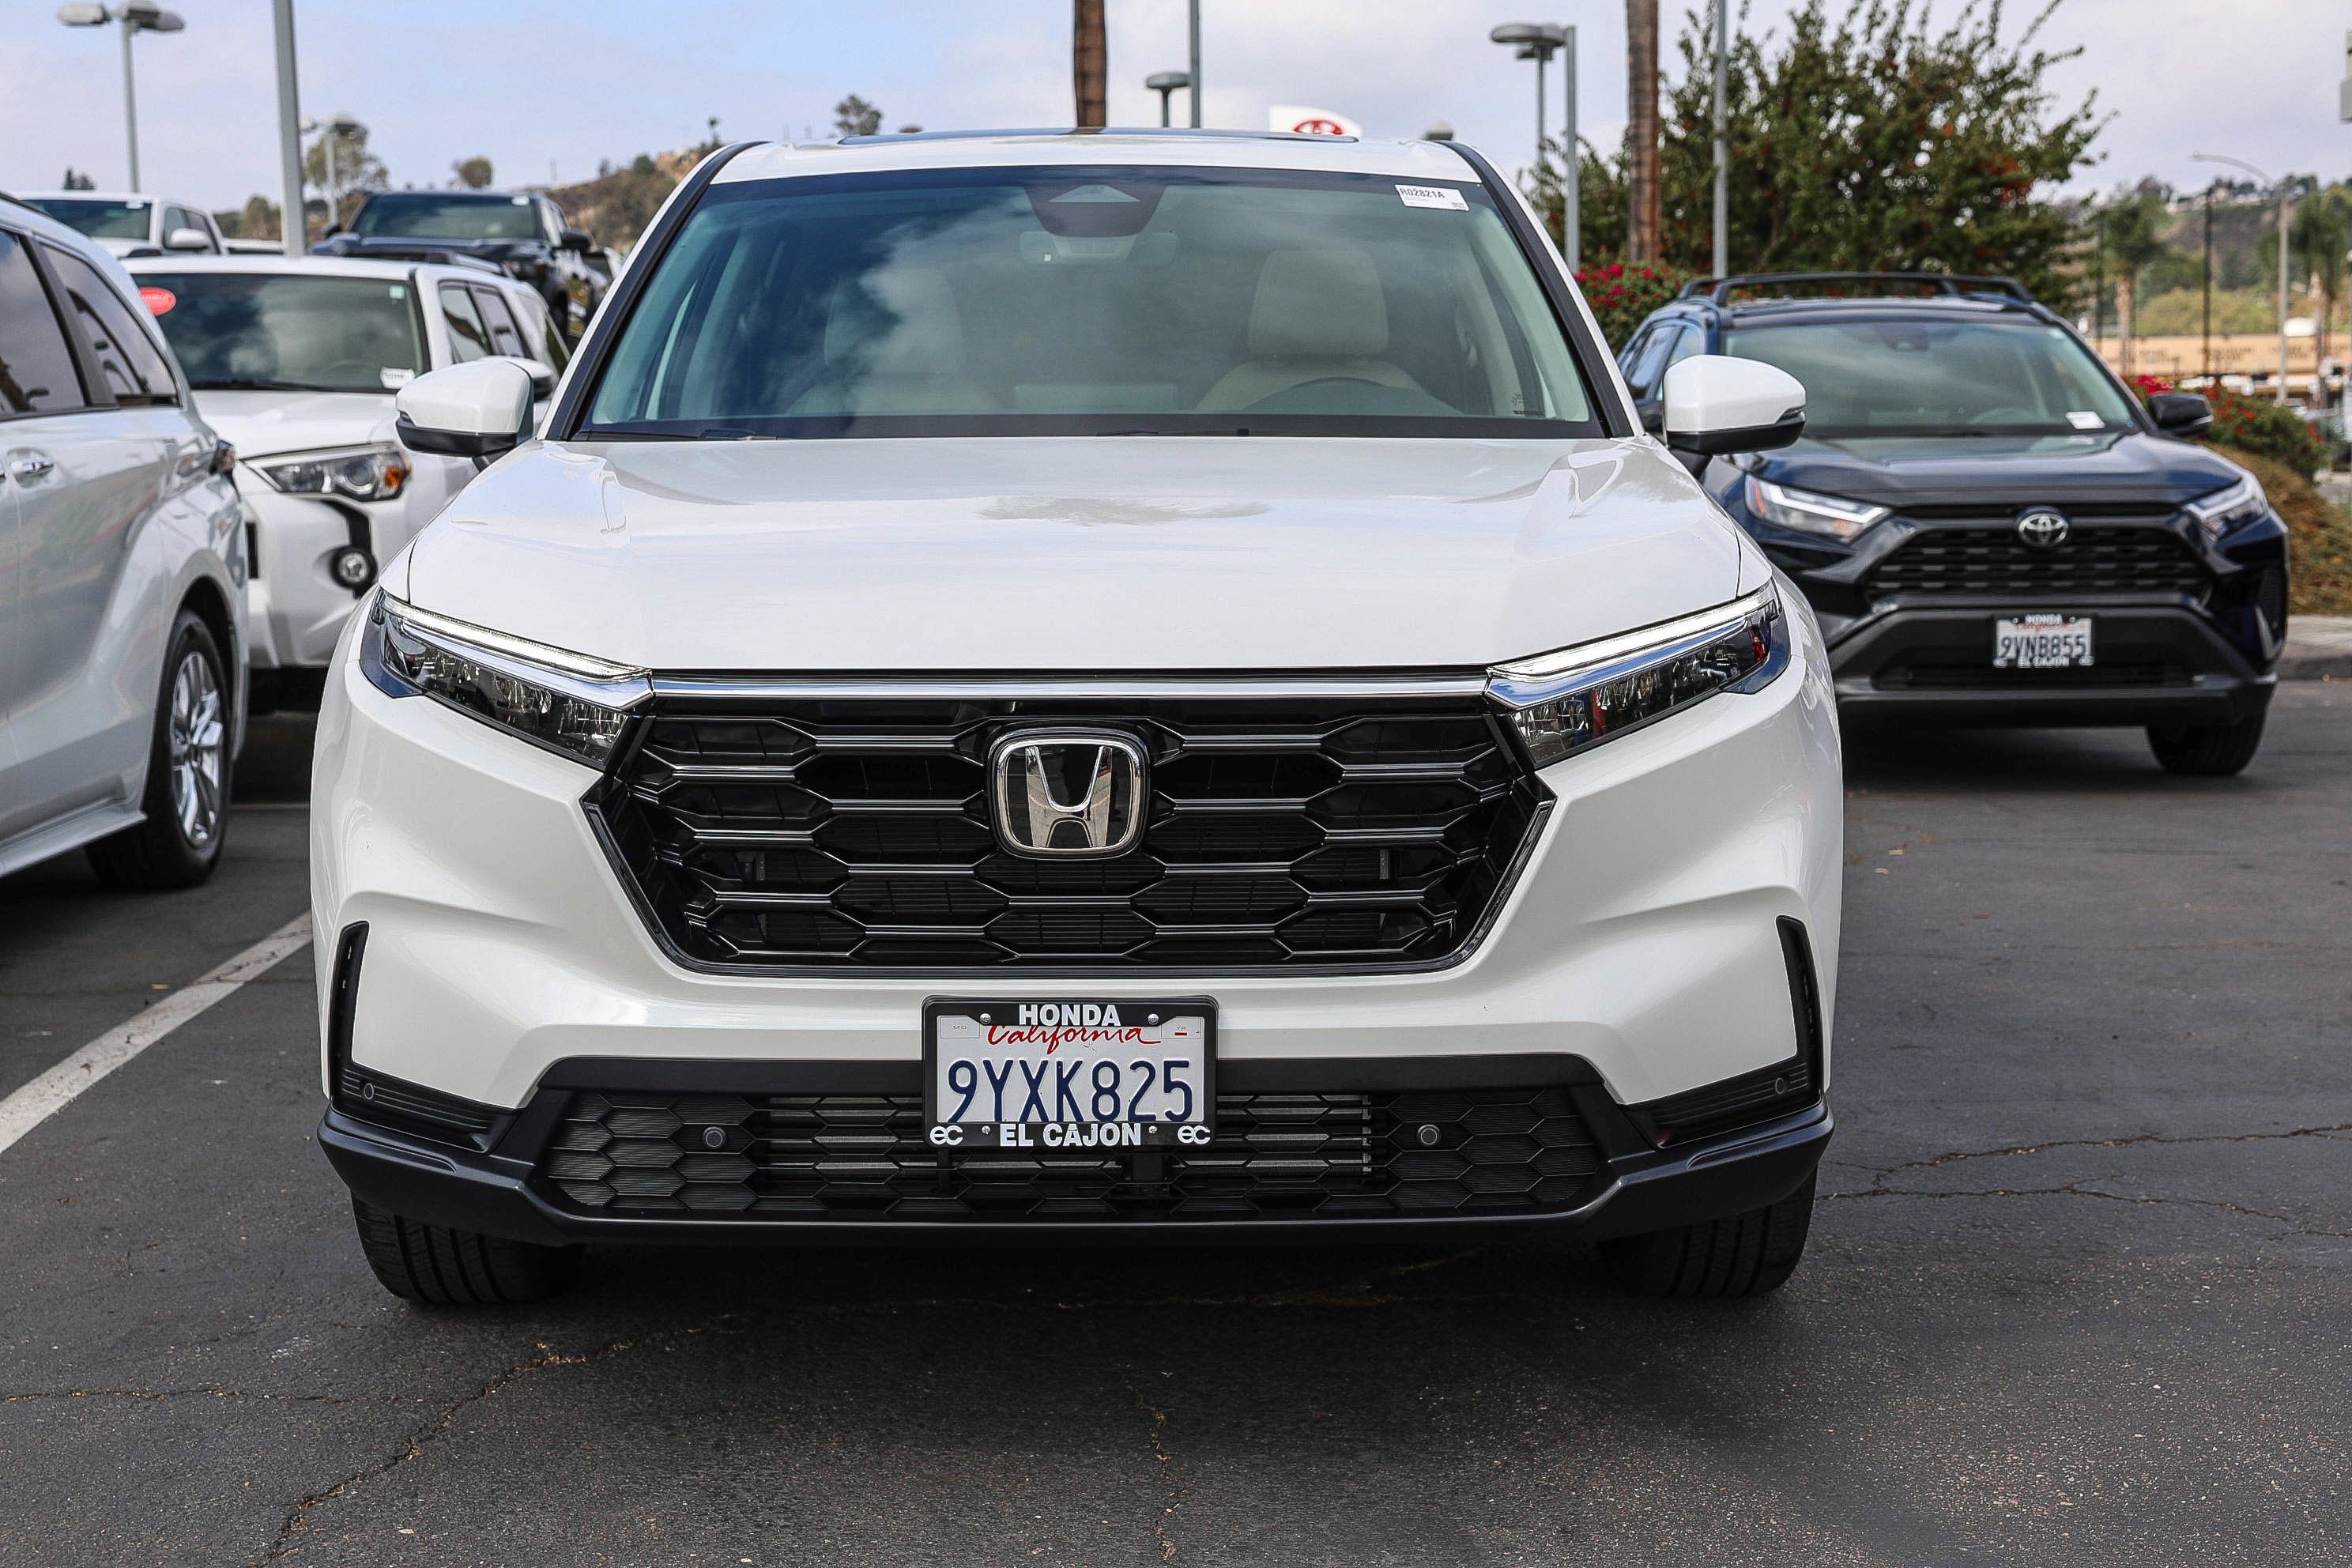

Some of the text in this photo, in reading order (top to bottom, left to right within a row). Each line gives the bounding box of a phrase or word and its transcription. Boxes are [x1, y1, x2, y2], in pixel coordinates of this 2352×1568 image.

[1019, 1004, 1121, 1027] HONDA
[987, 1025, 1162, 1055] California
[947, 1059, 1193, 1122] 9YXK825
[1000, 1122, 1141, 1147] EL CAJON
